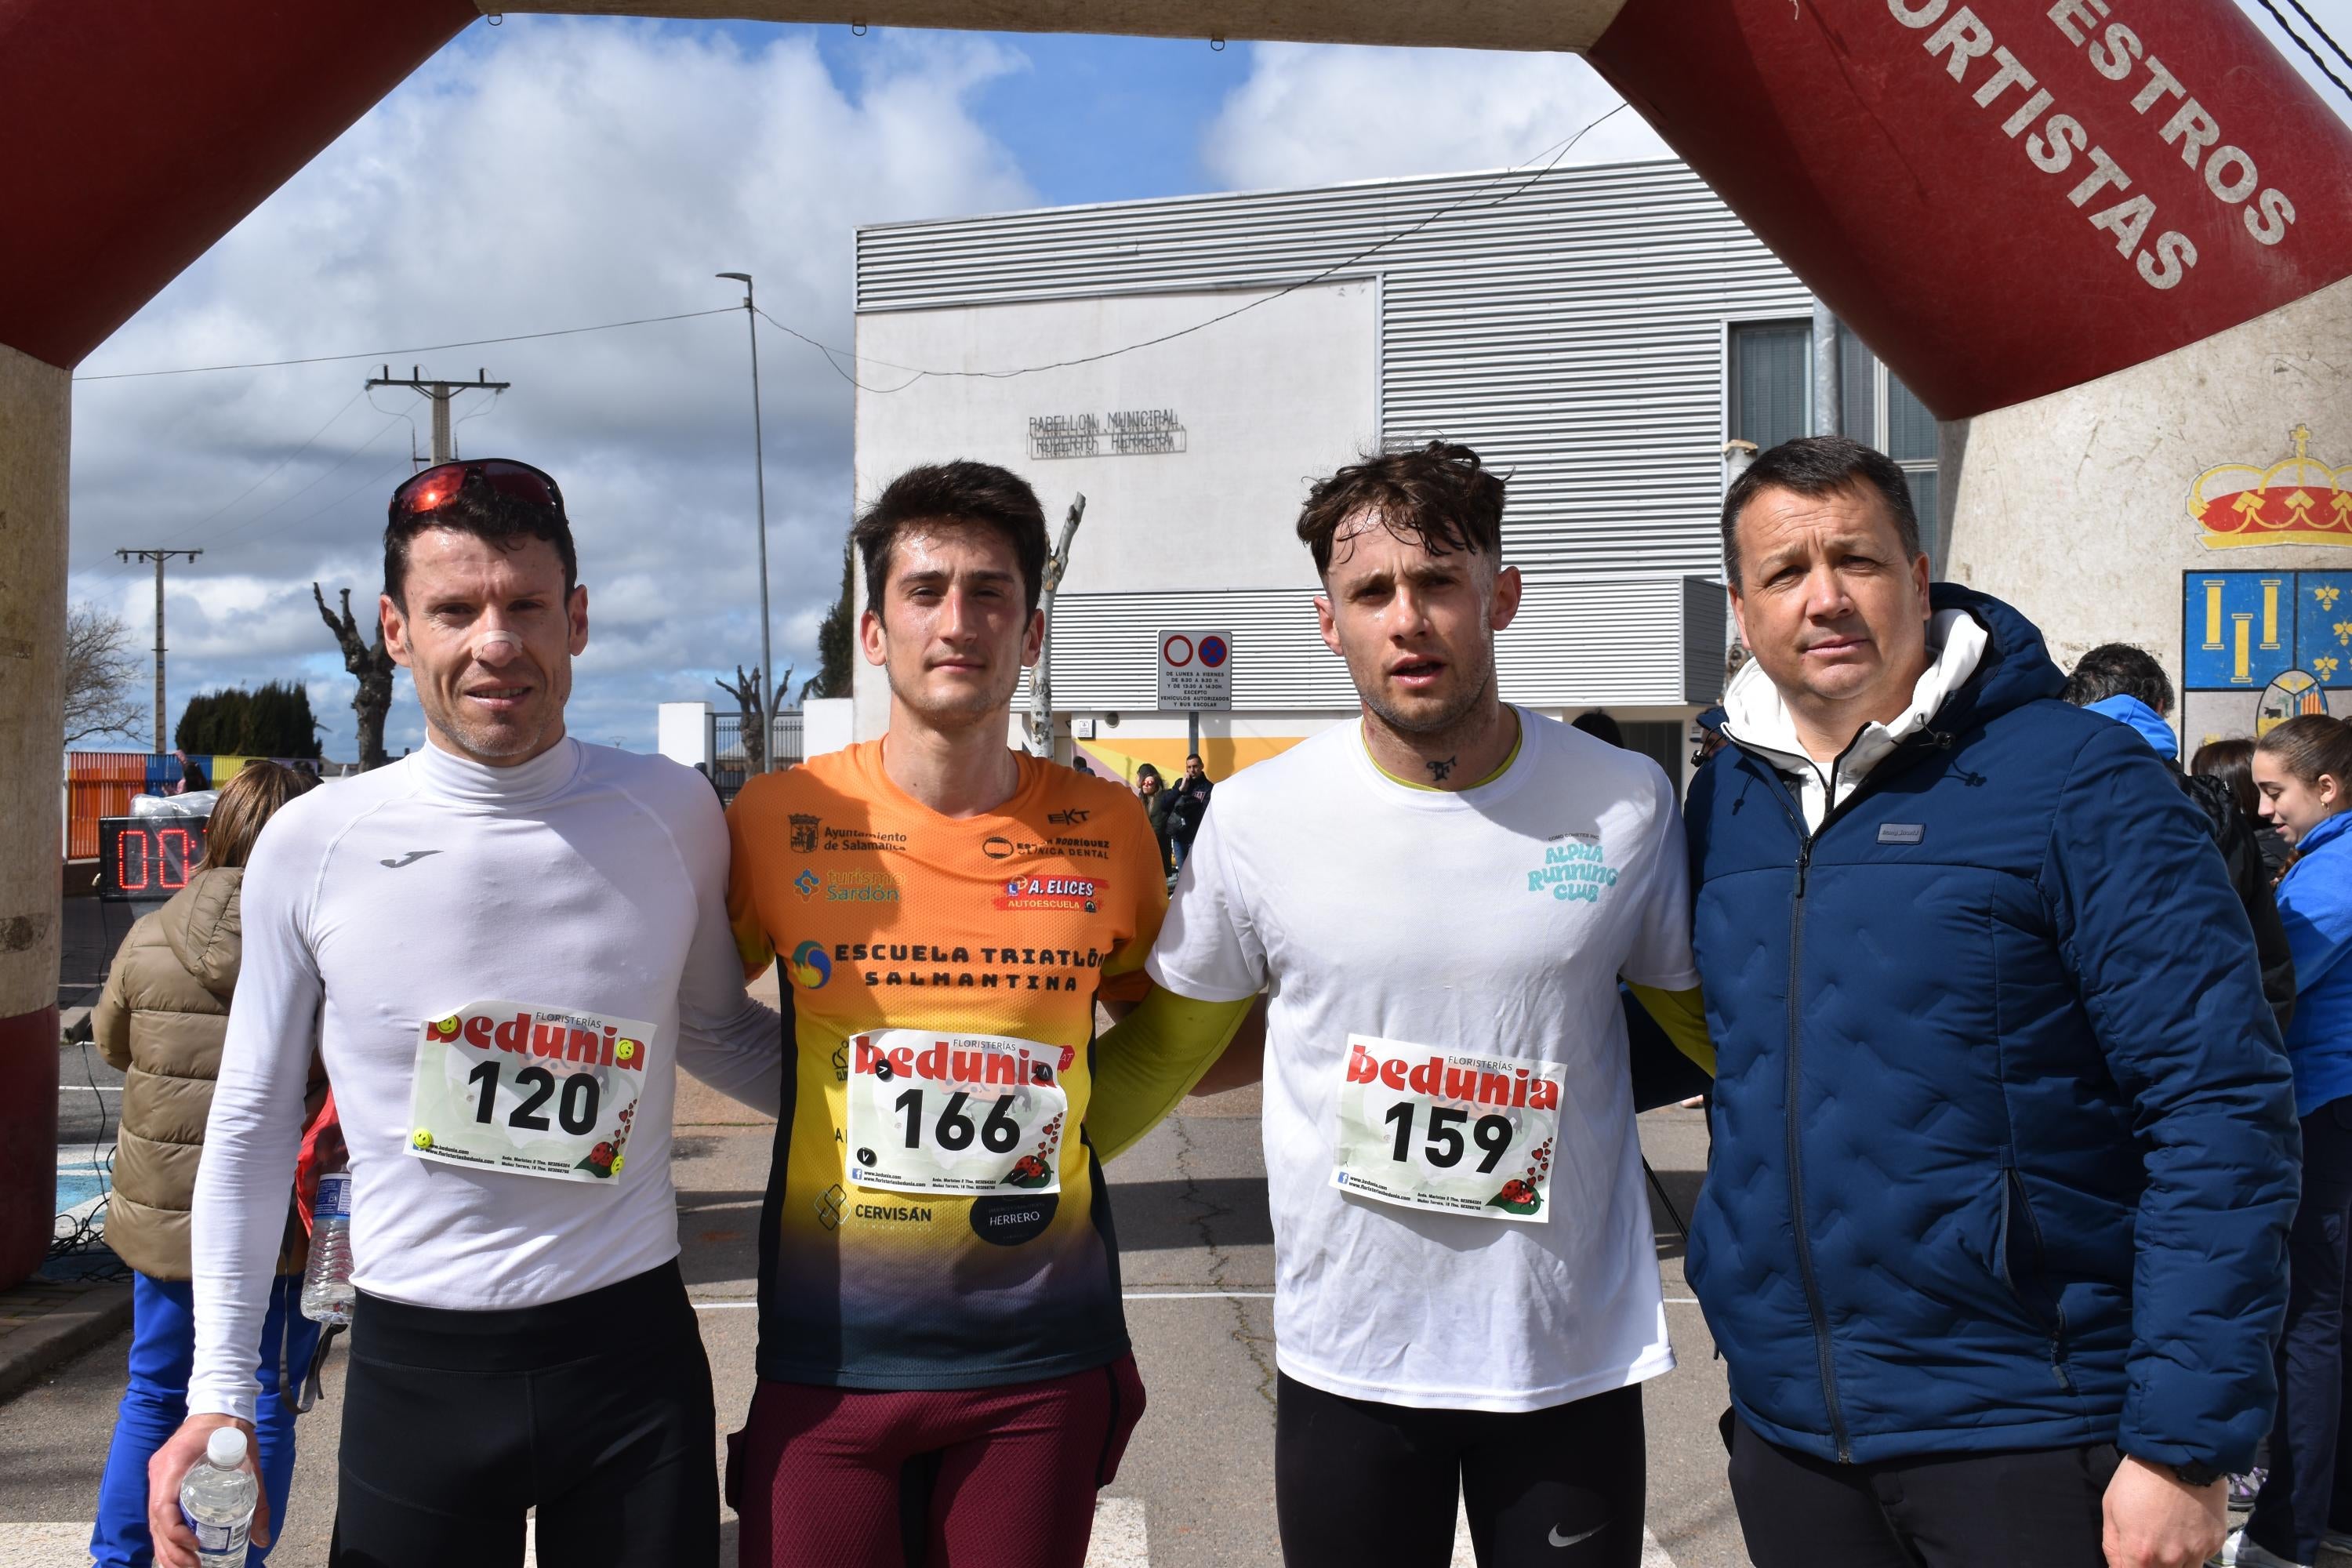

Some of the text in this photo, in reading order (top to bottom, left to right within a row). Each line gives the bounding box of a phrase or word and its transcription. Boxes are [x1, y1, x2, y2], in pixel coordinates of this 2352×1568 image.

[1108, 408, 1178, 429] MUNICIPAL
[1036, 432, 1171, 453] ROBERTO HERRERA
[825, 826, 907, 842] Ayuntamiento
[824, 840, 838, 851] de
[1069, 848, 1109, 859] DENTAL
[1544, 843, 1603, 864] ALPHA
[827, 884, 900, 902] Sardón
[1028, 879, 1094, 897] A. ELICES
[1553, 883, 1599, 902] CLUB
[1007, 899, 1080, 909] AUTOESCUELA
[835, 944, 970, 964] ESCUELA
[865, 971, 1077, 992] SALMANTINA
[535, 1011, 602, 1029] FLORISTERÍAS
[953, 1039, 1017, 1051] FLORISTERÍAS
[855, 1036, 1058, 1089] bedunia
[1448, 1055, 1513, 1072] FLORISTERÍAS
[1346, 1044, 1559, 1111] bedunia
[468, 1060, 601, 1136] 120
[895, 1088, 1021, 1154] 166
[1385, 1101, 1514, 1174] 159
[855, 1203, 932, 1222] CERVISÁN
[989, 1210, 1040, 1226] HERRERO
